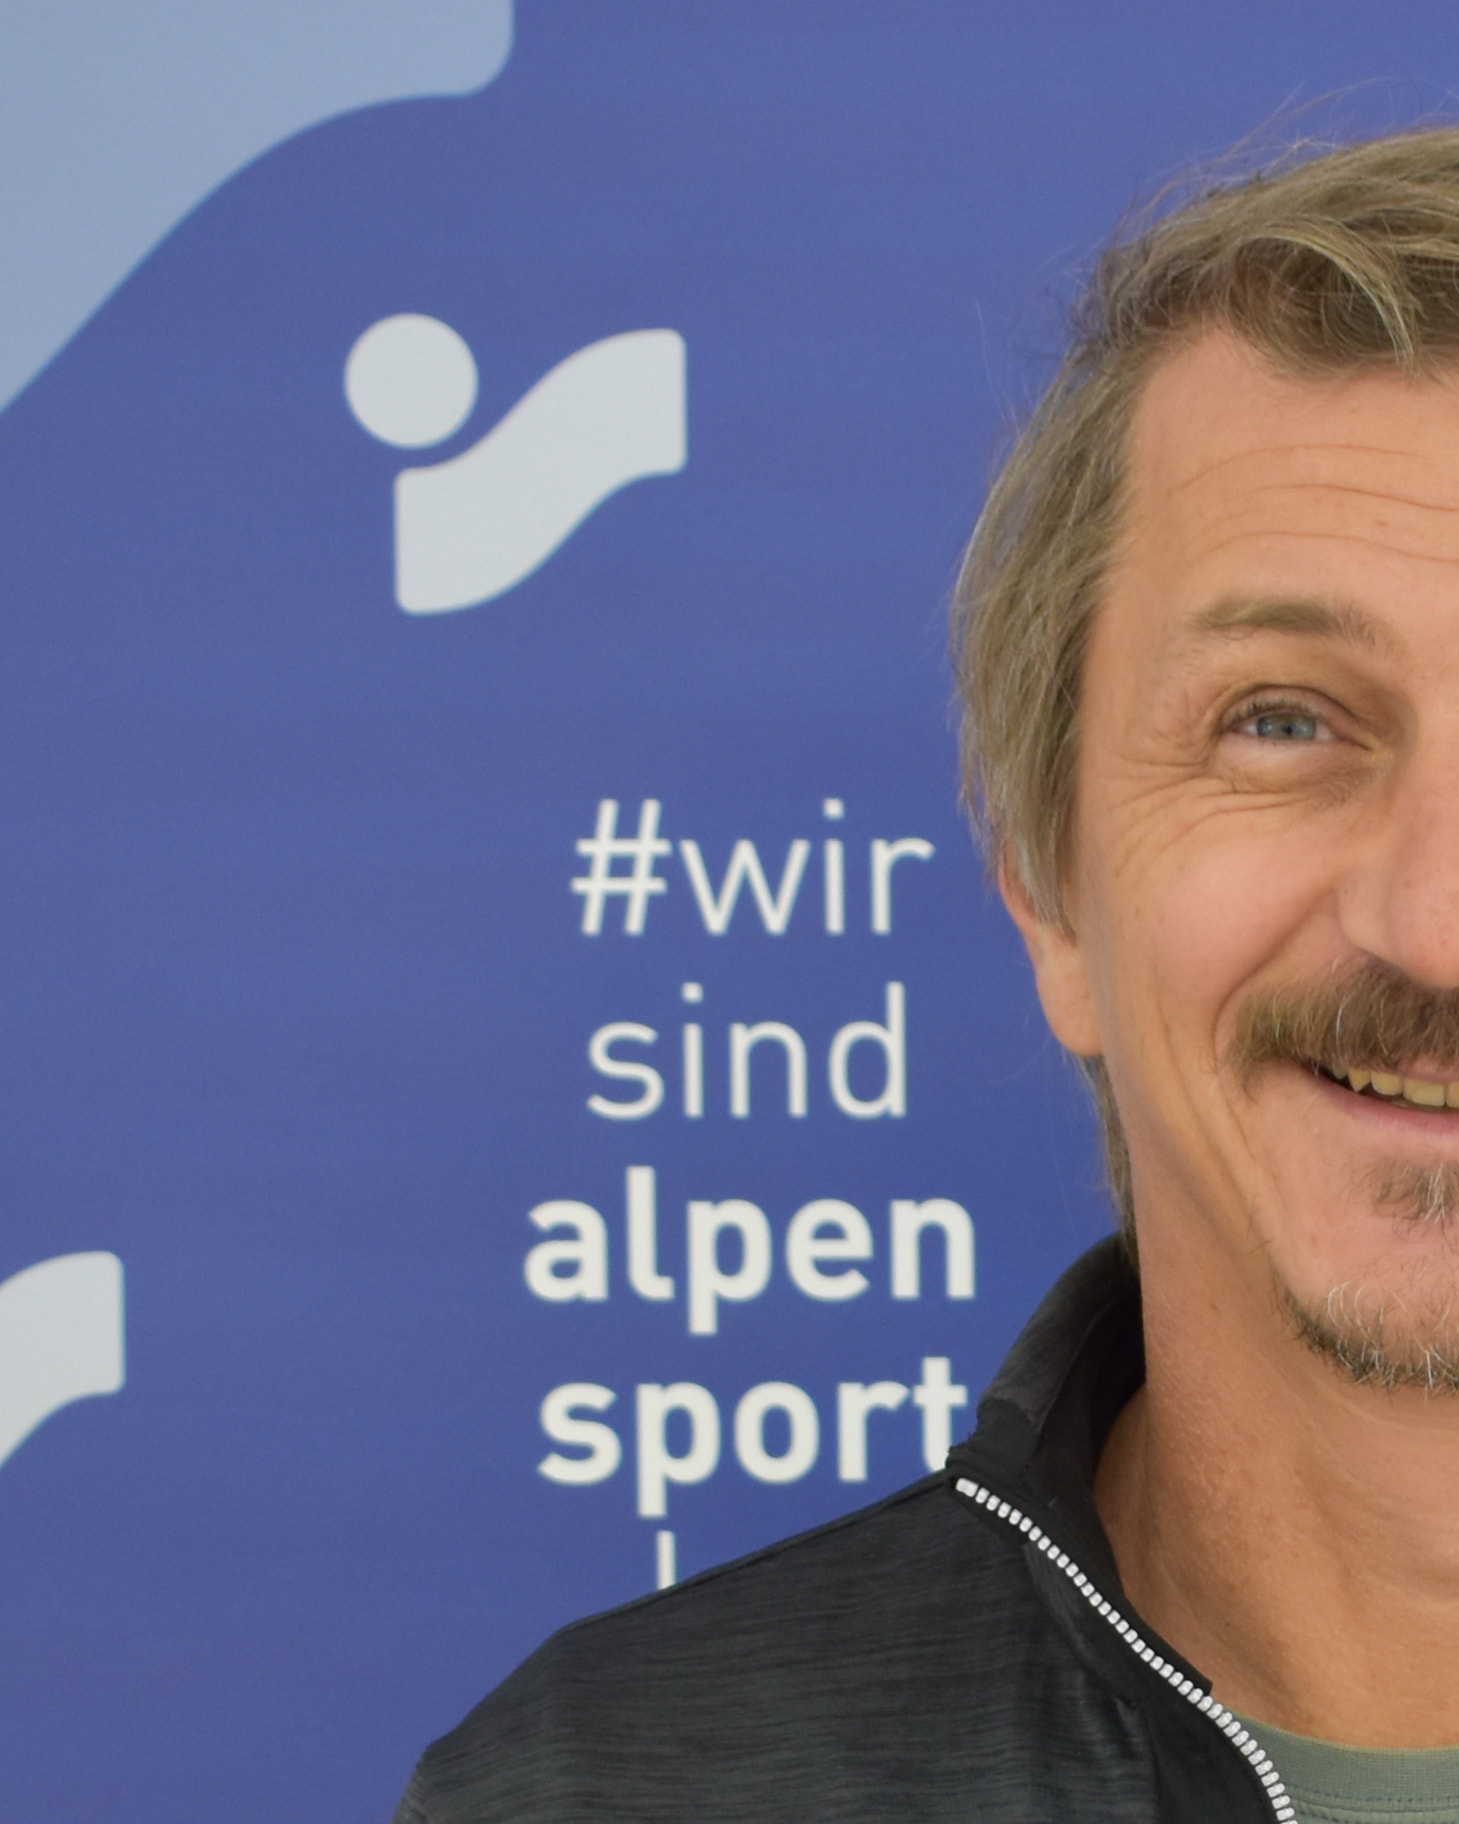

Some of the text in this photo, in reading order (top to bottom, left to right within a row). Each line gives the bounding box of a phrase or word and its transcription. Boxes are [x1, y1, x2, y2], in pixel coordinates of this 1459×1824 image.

[571, 798, 934, 936] #wir
[587, 981, 906, 1120] sind
[523, 1165, 975, 1335] alpen
[538, 1356, 969, 1518] sport
